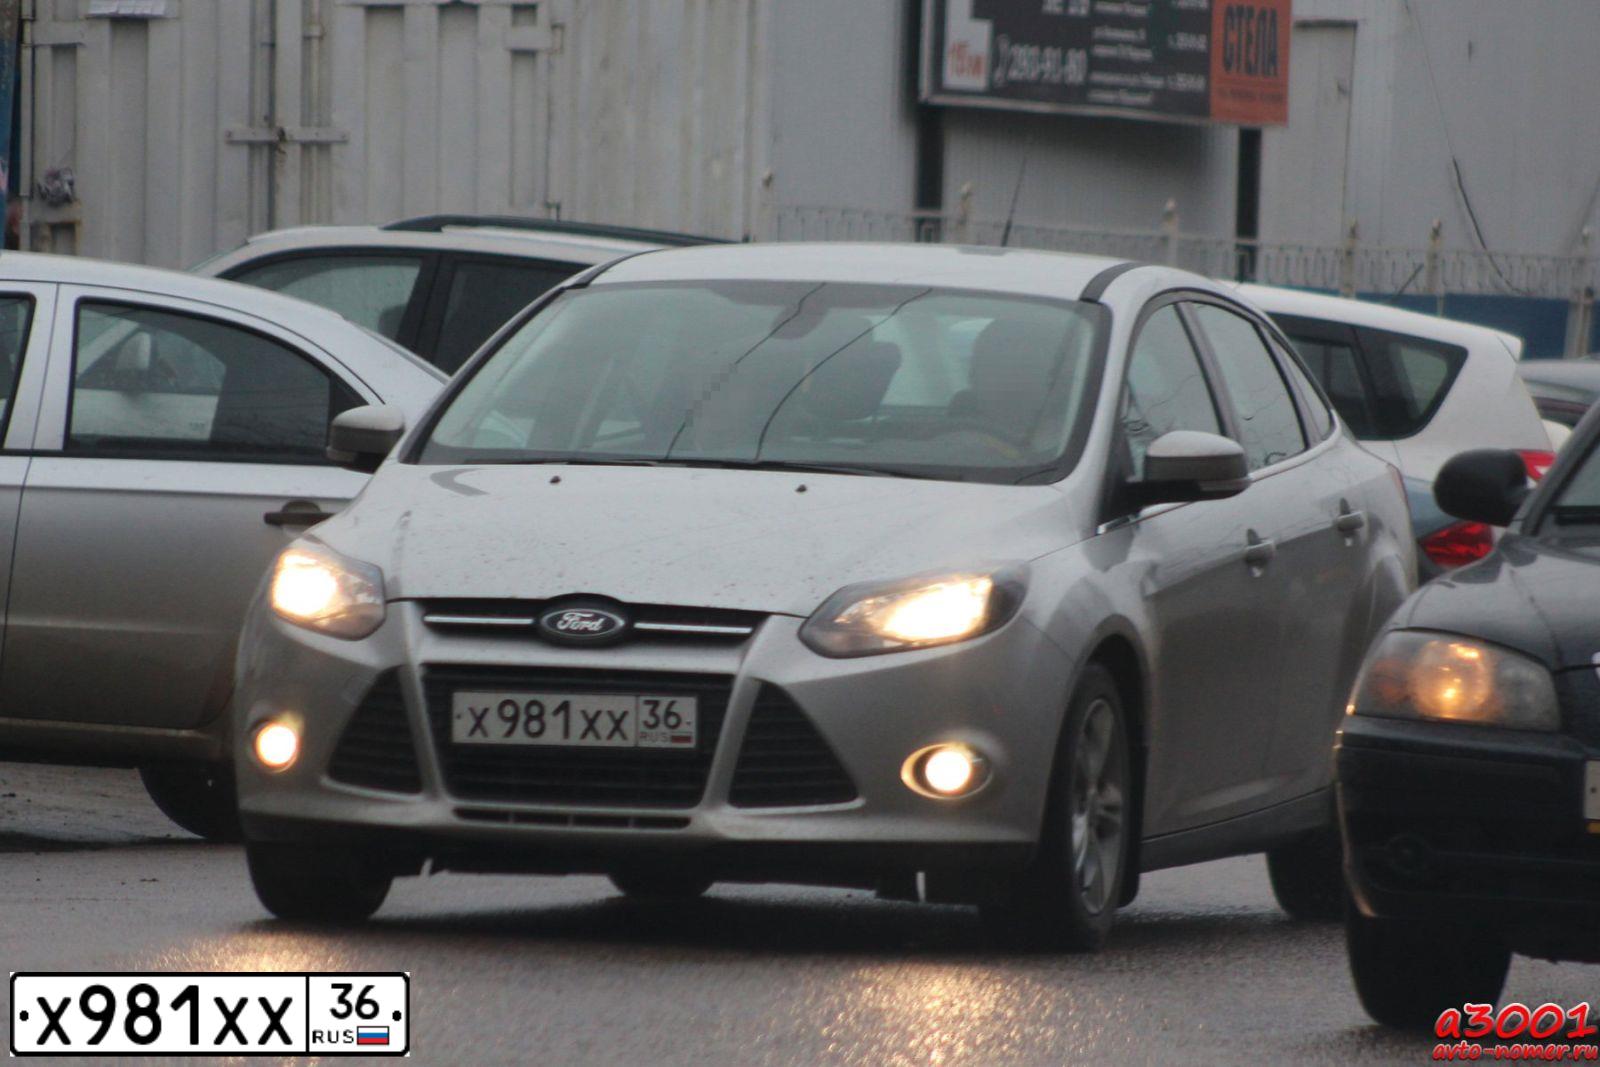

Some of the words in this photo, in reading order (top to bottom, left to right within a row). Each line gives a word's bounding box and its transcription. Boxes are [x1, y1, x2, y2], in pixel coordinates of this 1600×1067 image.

[1223, 5, 1278, 77] СТЕЛА
[557, 612, 606, 631] Ford
[642, 700, 682, 730] 36
[639, 732, 669, 743] RUS
